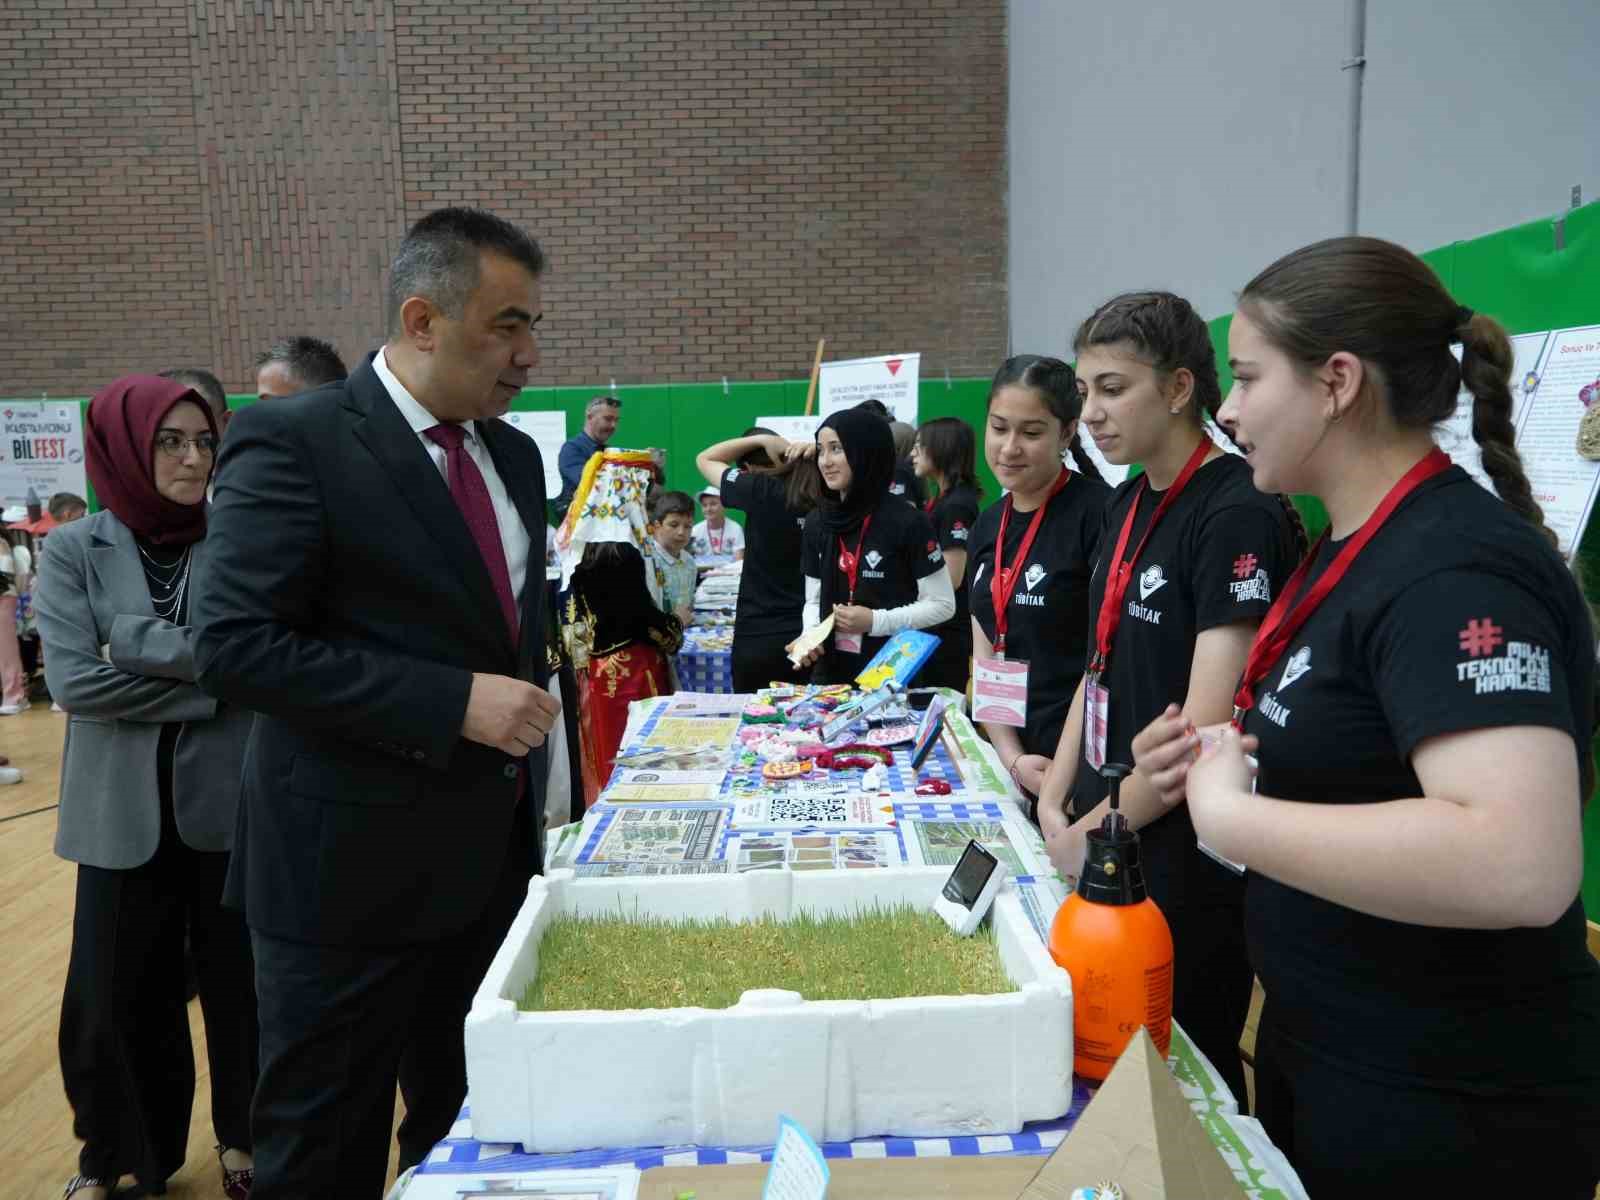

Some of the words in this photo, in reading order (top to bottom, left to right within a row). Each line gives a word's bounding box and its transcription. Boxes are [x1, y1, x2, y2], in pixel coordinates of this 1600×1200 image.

[5, 422, 72, 434] KASTAMONU
[12, 435, 65, 460] BİLFEST
[1015, 592, 1045, 606] TÜBİTAK
[1128, 600, 1162, 625] TÜBİTAK
